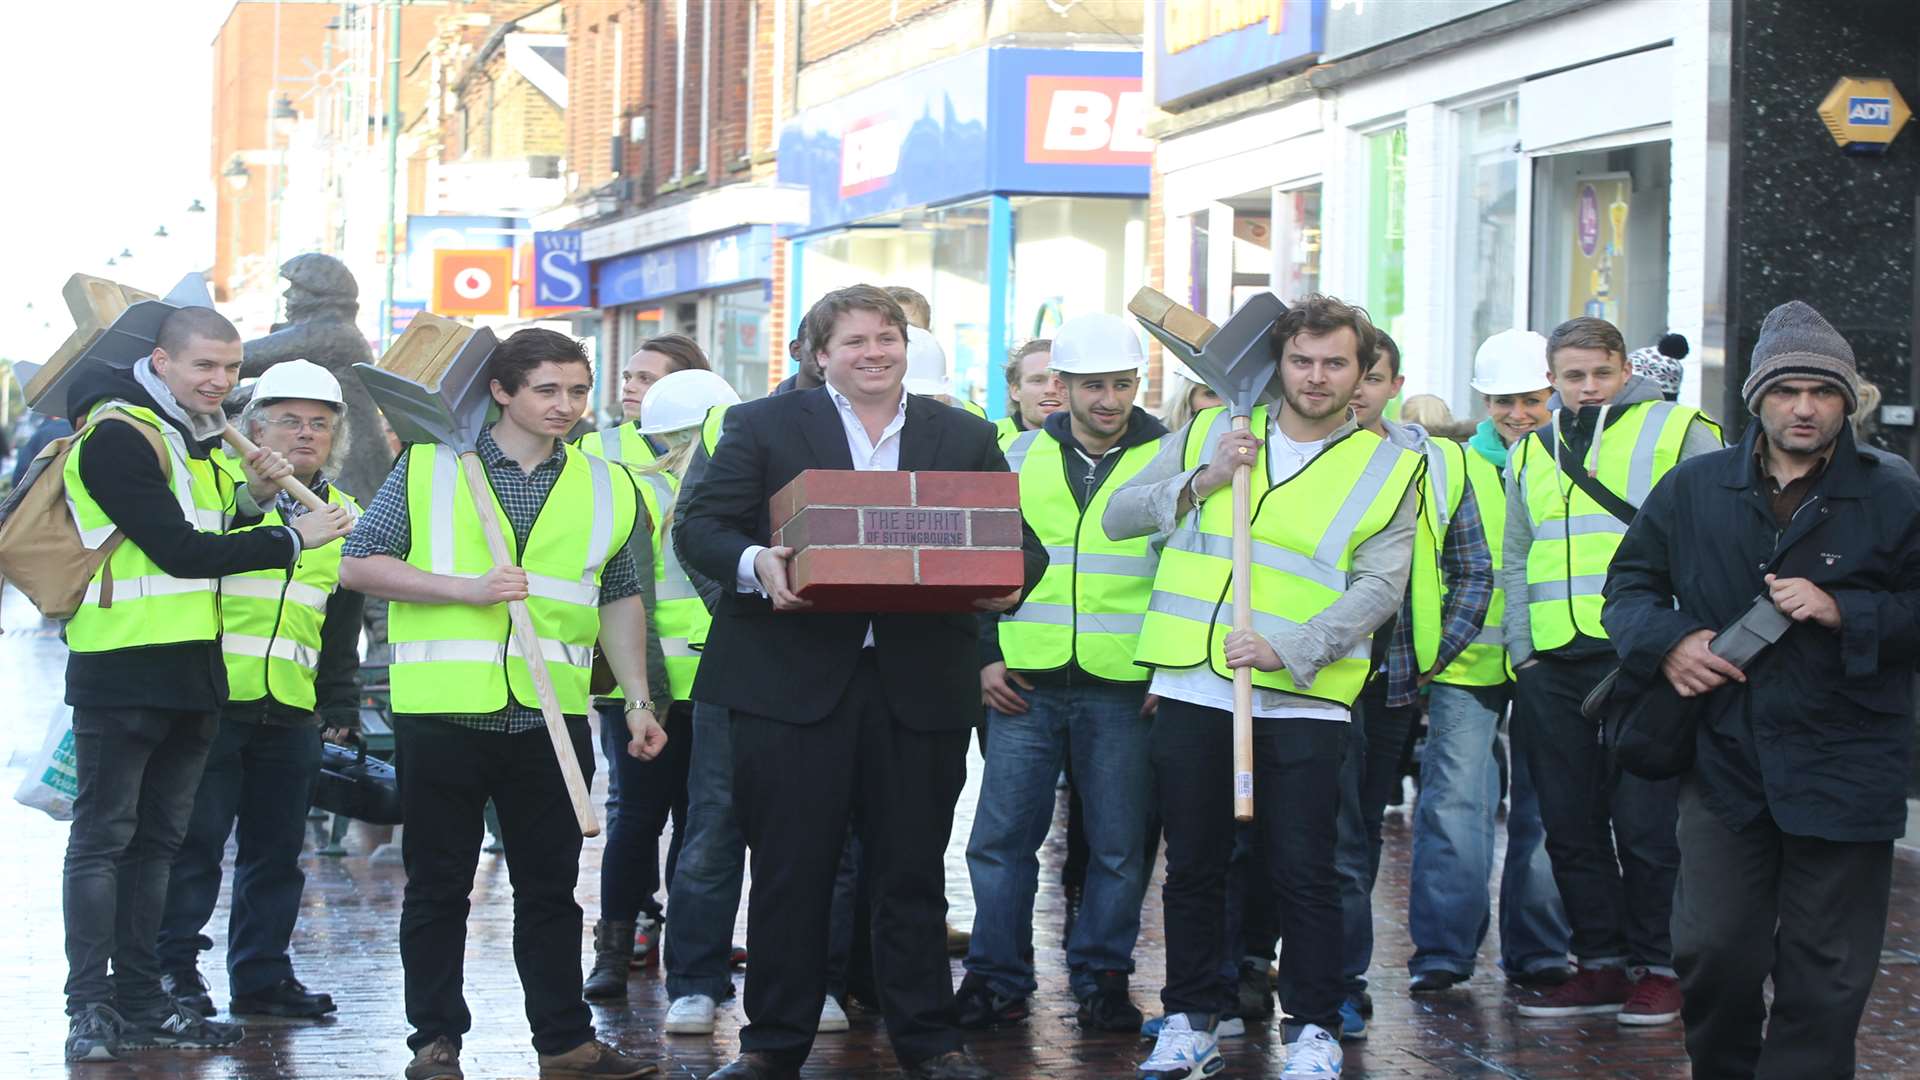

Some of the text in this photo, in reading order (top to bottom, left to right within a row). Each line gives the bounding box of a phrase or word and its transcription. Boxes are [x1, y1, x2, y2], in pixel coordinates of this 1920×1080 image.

[1848, 103, 1891, 121] ADT
[541, 250, 582, 303] S
[867, 511, 961, 531] THE SPIRIT
[866, 531, 964, 546] OF SITTINGBOURNE
